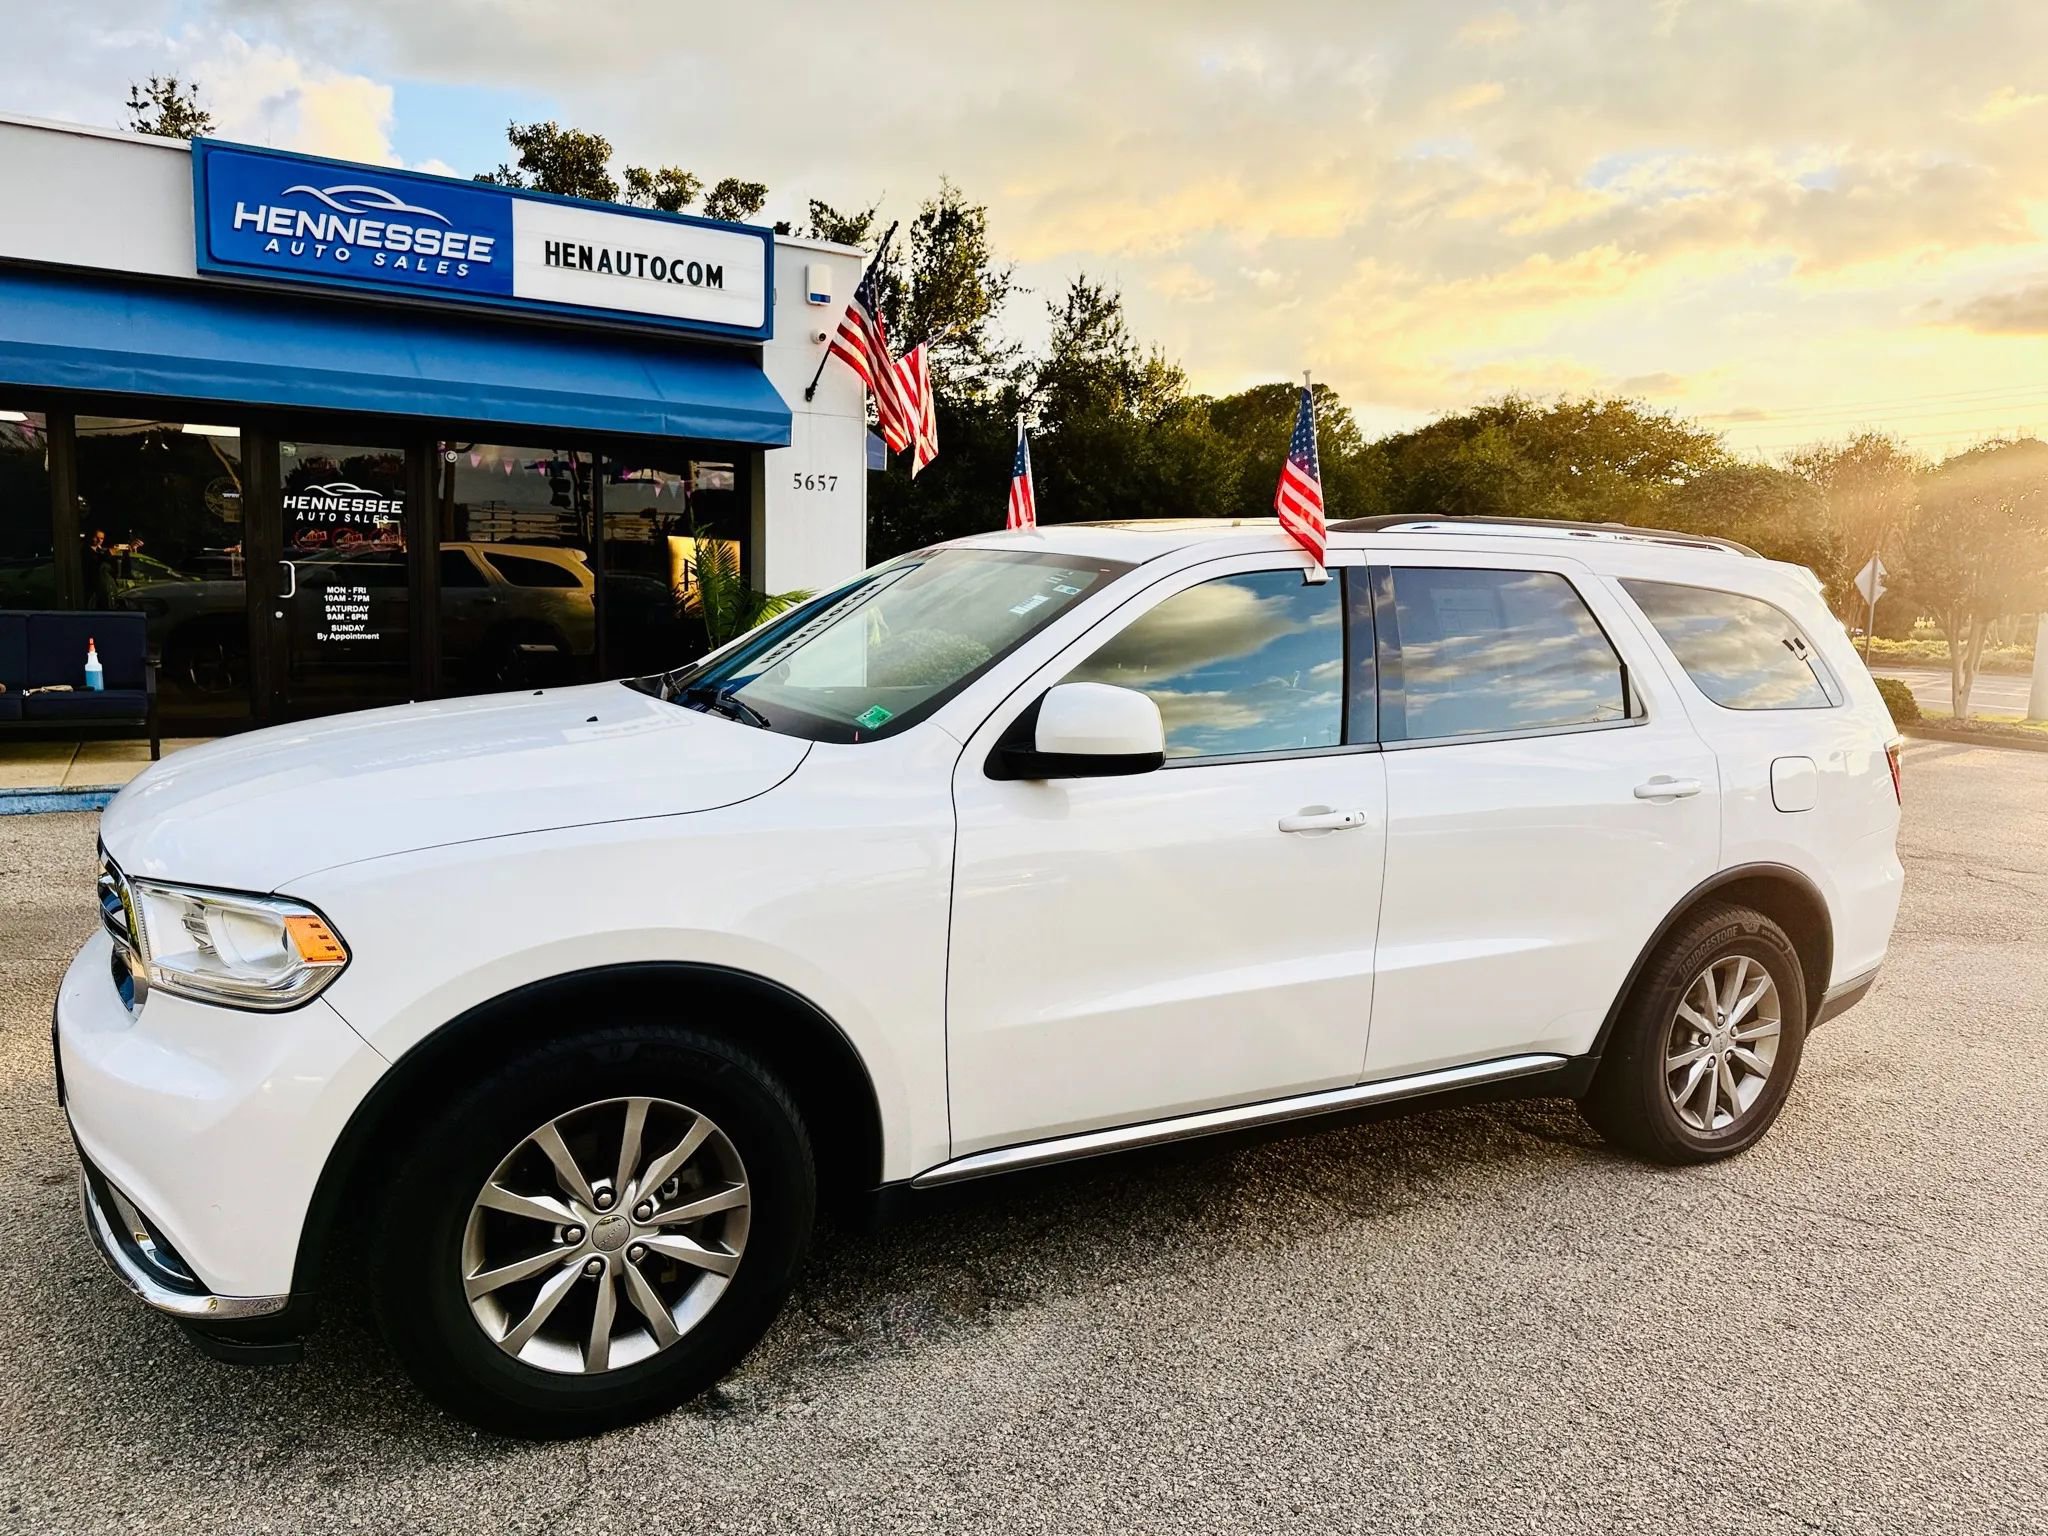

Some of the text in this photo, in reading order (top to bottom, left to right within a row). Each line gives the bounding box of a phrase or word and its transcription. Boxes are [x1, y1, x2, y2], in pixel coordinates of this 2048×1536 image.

[233, 201, 495, 263] HENNESSEE
[265, 238, 469, 277] AUTO SALES
[545, 240, 723, 289] HENAUTO.COM
[793, 472, 838, 492] 5657
[283, 495, 403, 513] HENNESSEE
[296, 511, 389, 523] AUTO SALES
[326, 586, 346, 594] MON
[352, 586, 367, 594] FRI
[324, 594, 346, 602] 10AM
[325, 605, 370, 613] SATURDAY
[326, 613, 345, 621] 9AM
[331, 624, 365, 632] SUNDAY
[316, 632, 380, 641] By Appointment
